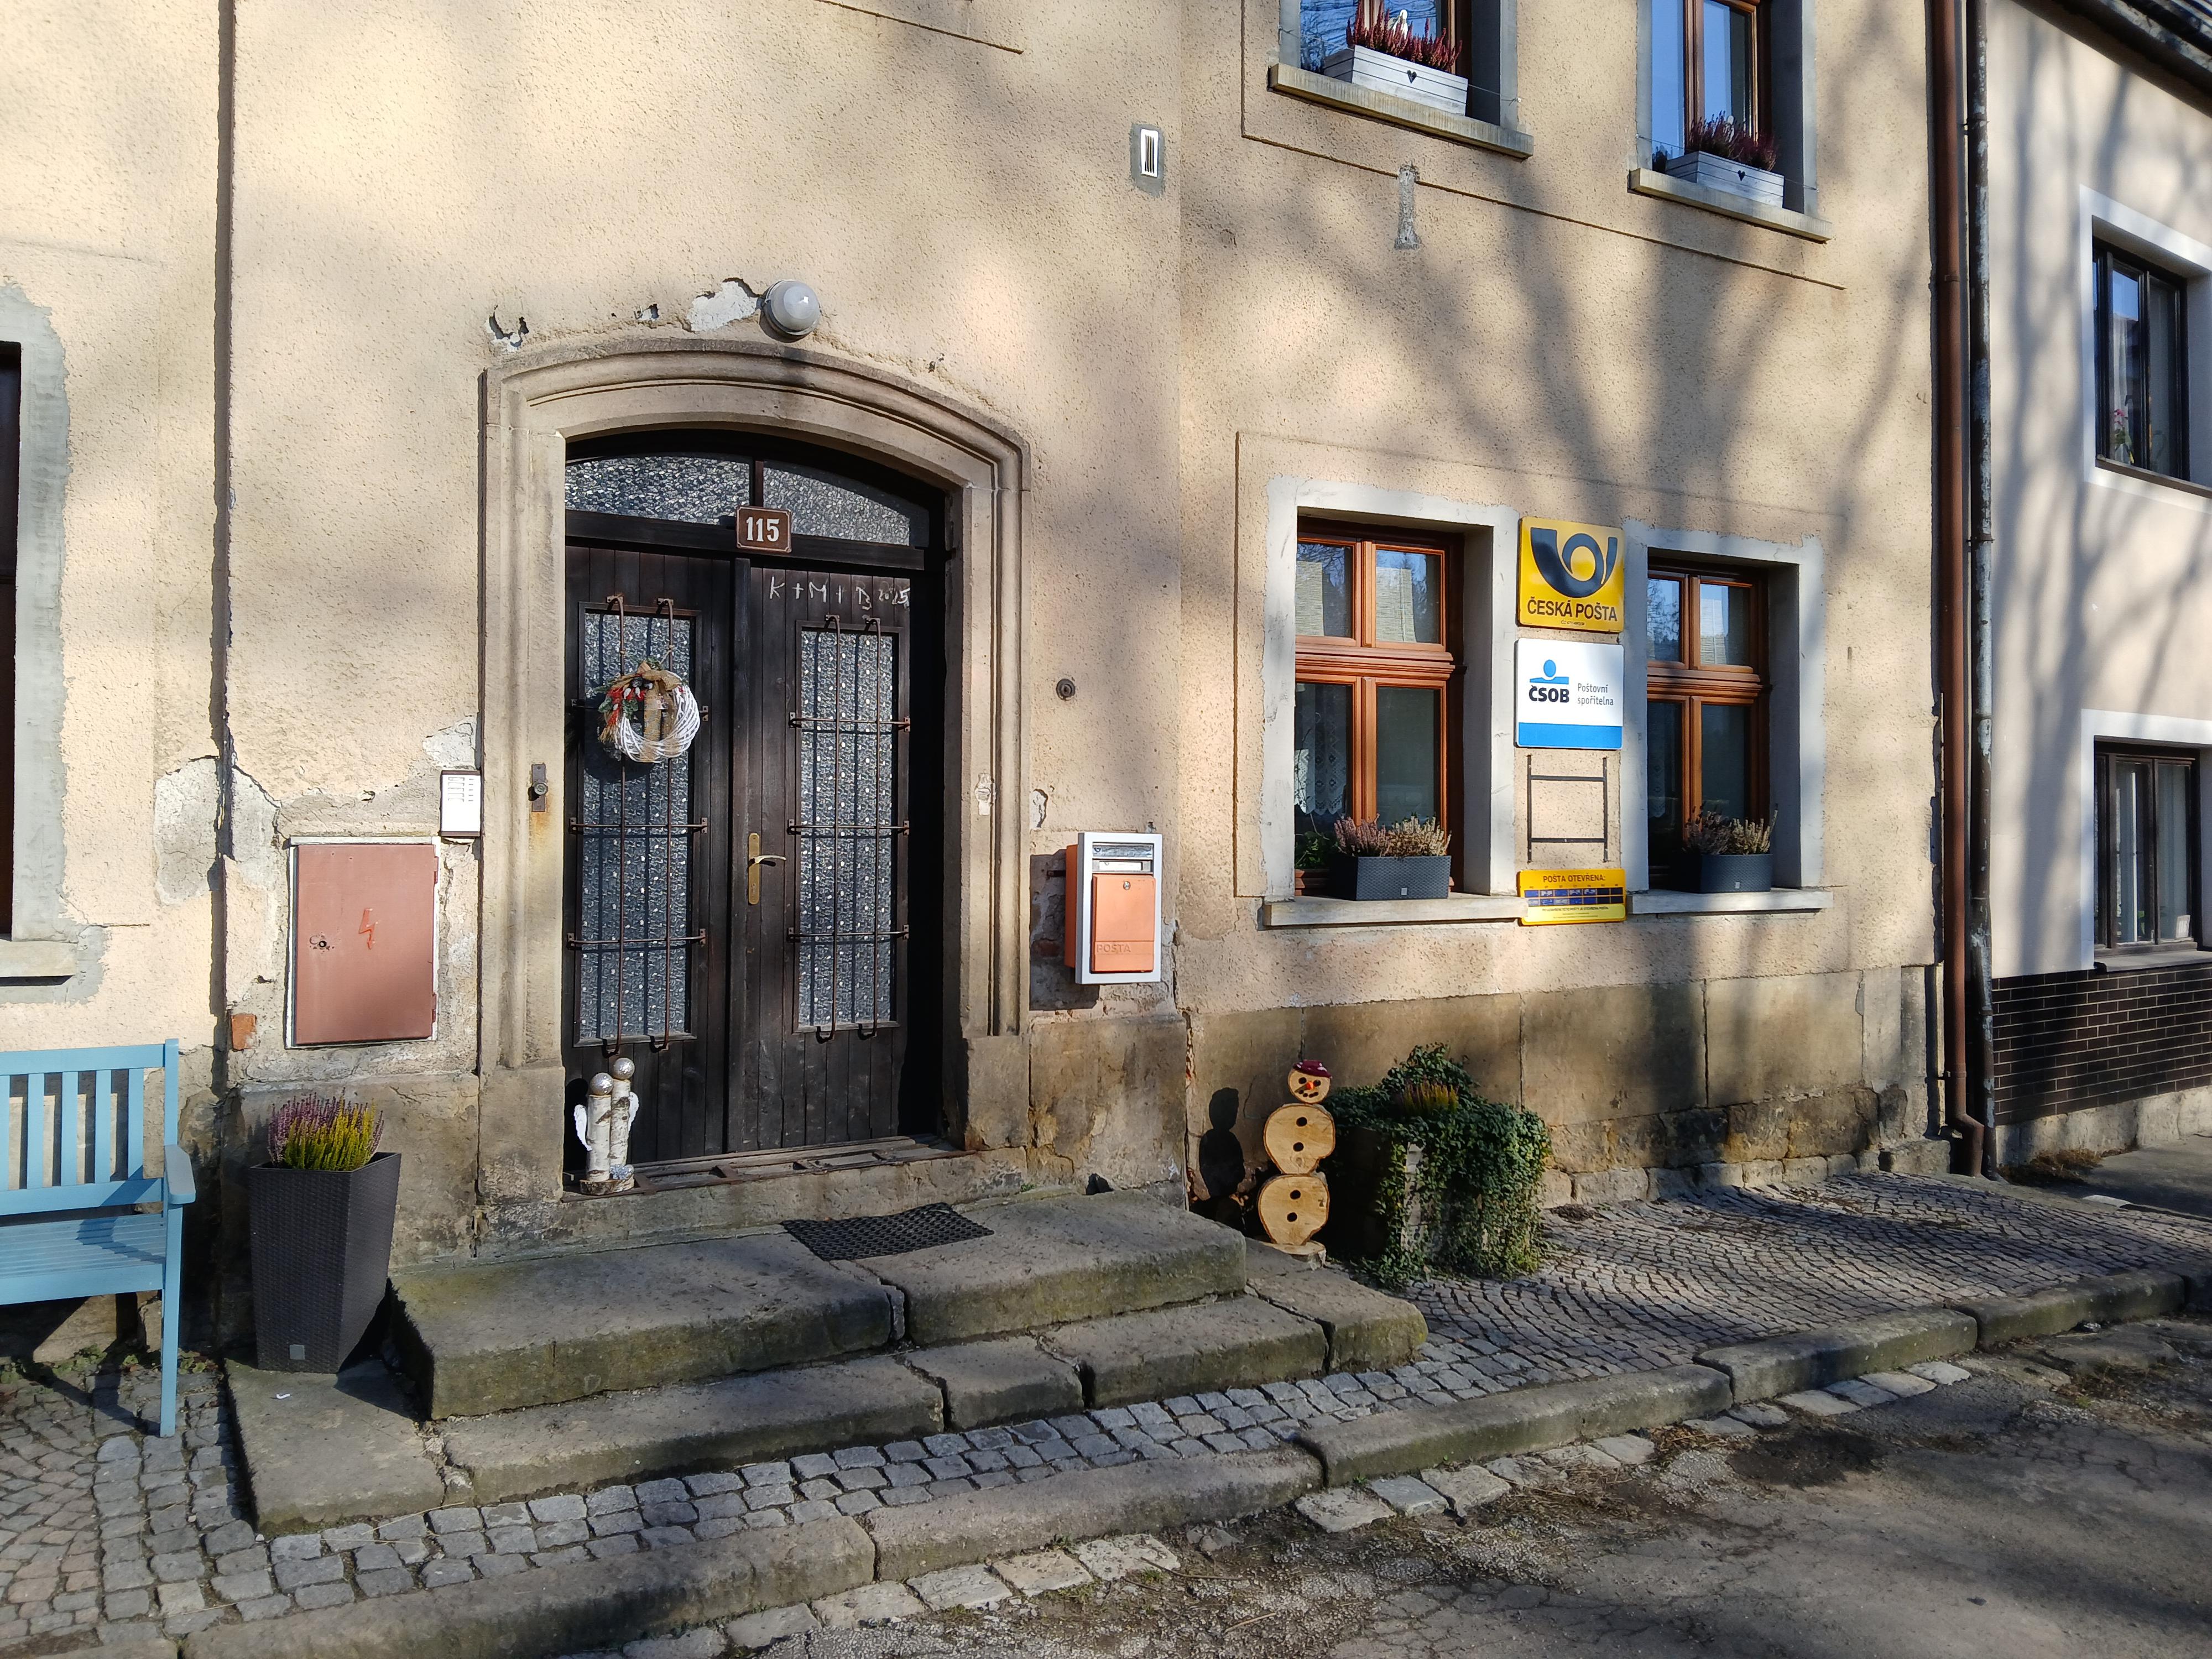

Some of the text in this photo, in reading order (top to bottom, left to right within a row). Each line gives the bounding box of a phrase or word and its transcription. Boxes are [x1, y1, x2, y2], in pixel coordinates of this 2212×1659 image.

[746, 517, 780, 542] 115
[1527, 596, 1618, 622] ČESKÁ POŠTA
[1528, 685, 1569, 702] ČSOB
[1578, 682, 1609, 693] Poštovní
[1577, 696, 1614, 706] spořitelna
[1543, 874, 1566, 883] POŠTA
